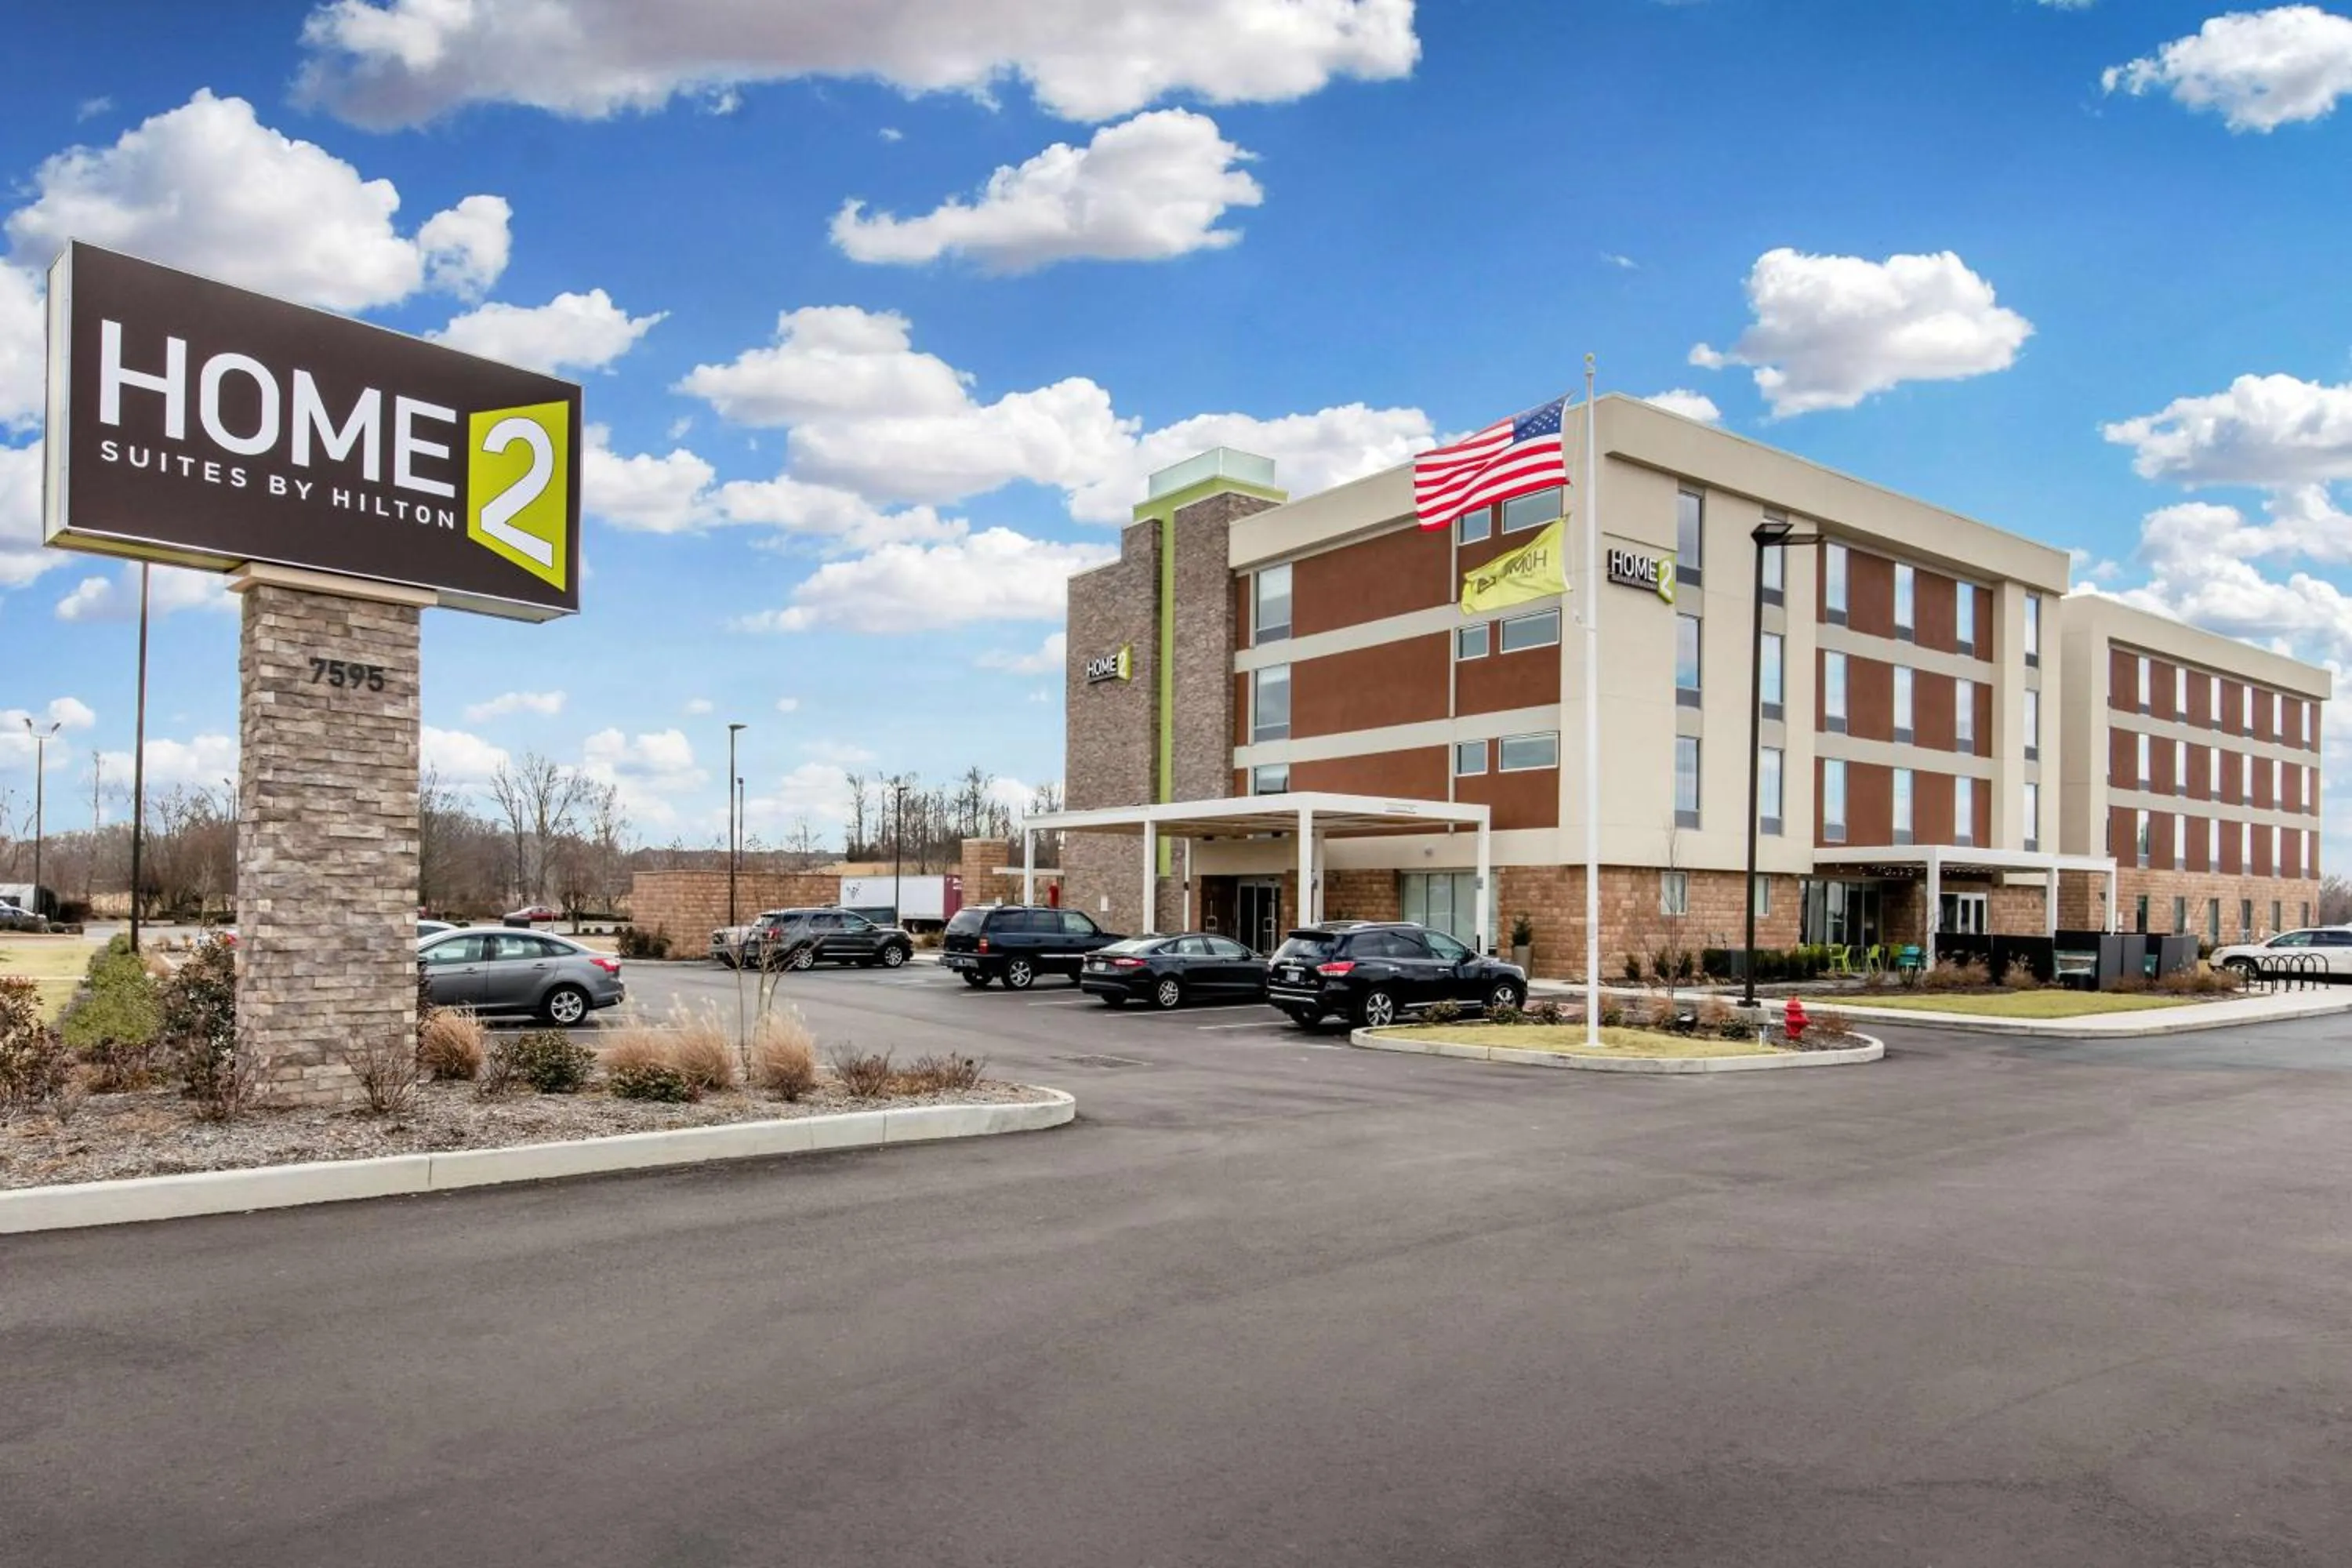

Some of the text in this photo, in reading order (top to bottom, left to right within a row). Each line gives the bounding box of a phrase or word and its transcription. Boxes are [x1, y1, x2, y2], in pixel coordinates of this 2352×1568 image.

[100, 318, 555, 569] HOME 2
[100, 440, 455, 530] SUITES BY HILTON
[1611, 550, 1658, 582] HOME
[1660, 559, 1672, 599] 2
[309, 657, 384, 691] 7595
[1087, 654, 1117, 677] HOME
